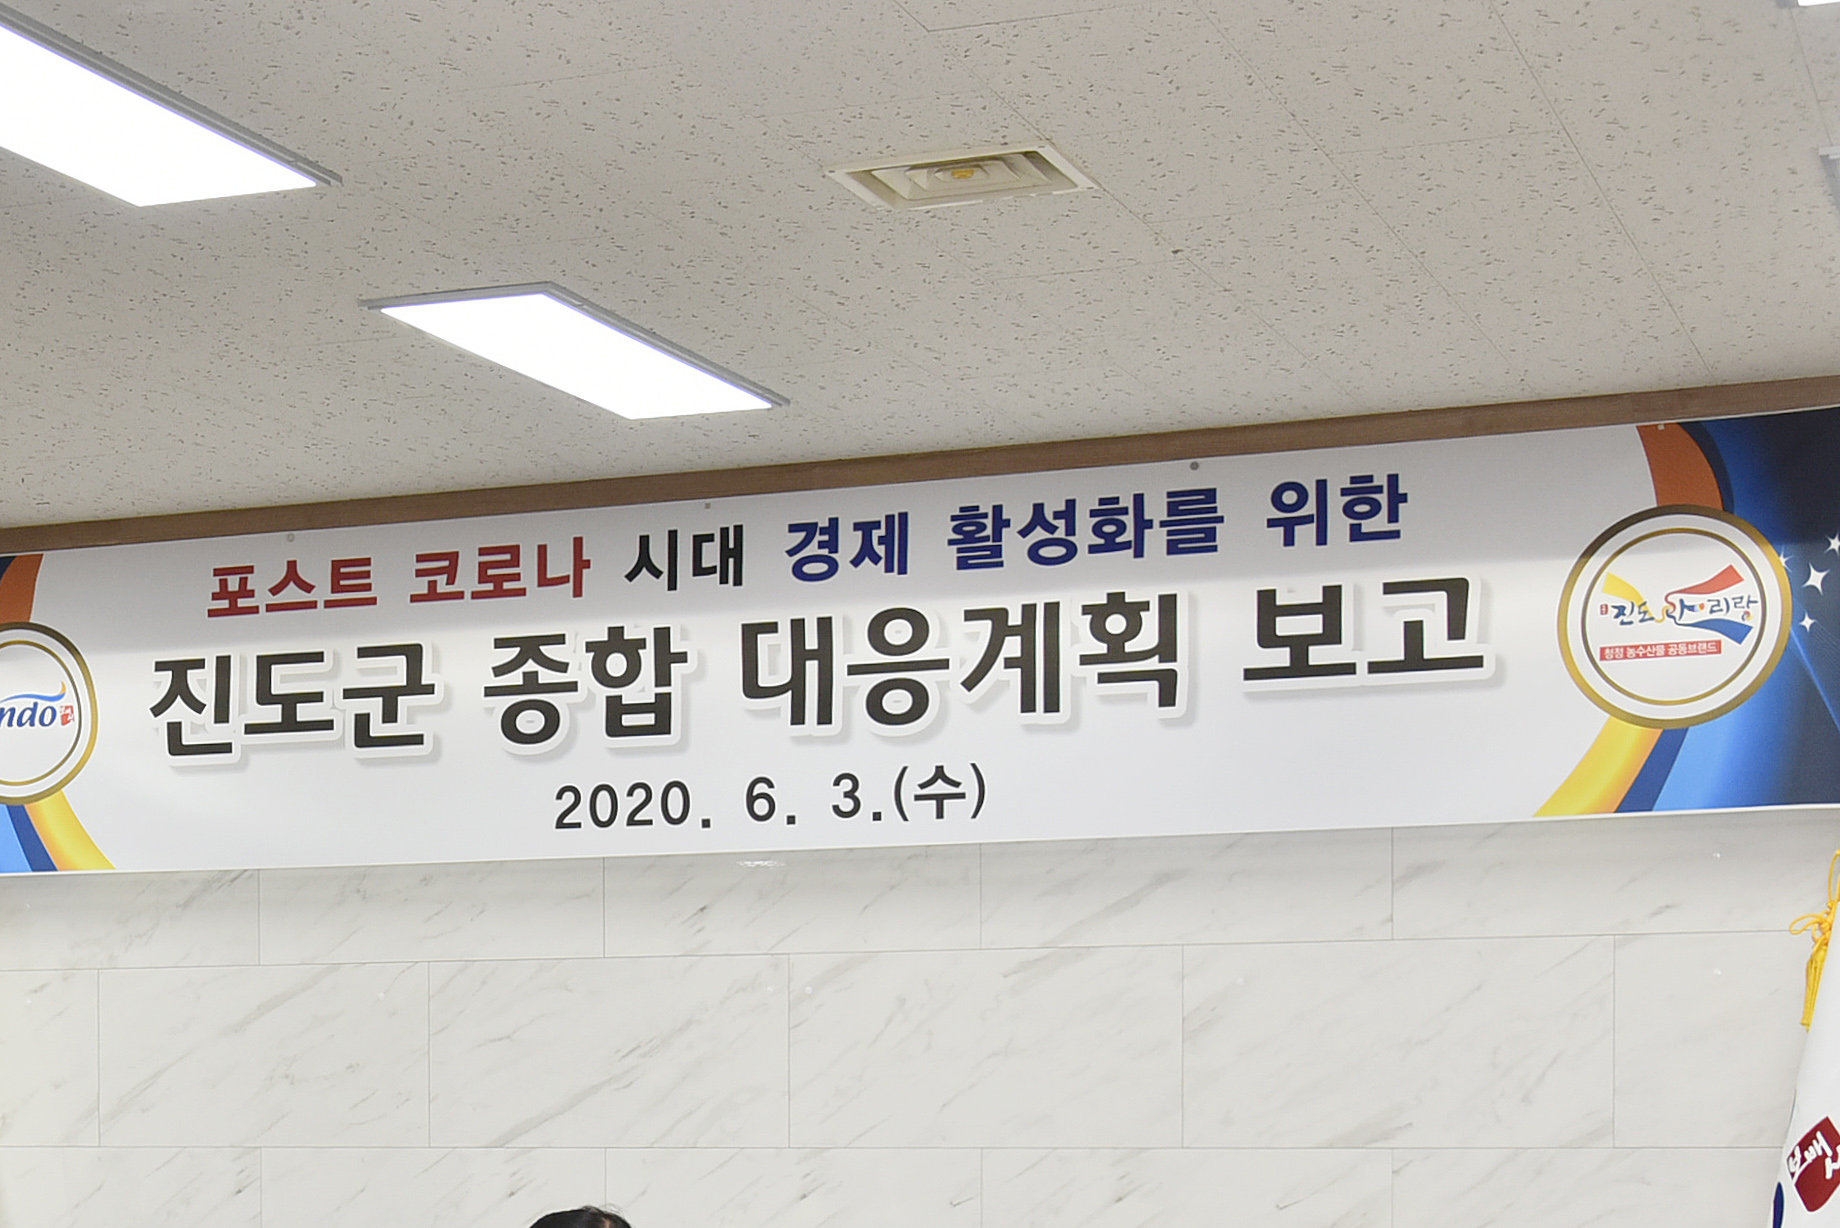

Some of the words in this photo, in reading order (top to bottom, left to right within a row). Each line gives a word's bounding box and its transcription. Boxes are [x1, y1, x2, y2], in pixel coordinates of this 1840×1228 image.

[208, 557, 377, 617] 포스트
[410, 536, 590, 603] 코로나
[625, 524, 743, 591] 시대
[785, 512, 908, 582] 경제
[948, 488, 1224, 570] 활성화를
[1267, 474, 1408, 547] 위한
[150, 644, 434, 756] 진도군
[485, 626, 687, 744] 종합
[742, 592, 1177, 725] 대응계획
[1244, 578, 1483, 680] 보고
[1604, 646, 1624, 660] 청정
[1626, 644, 1666, 659] 농수산물
[1667, 641, 1719, 656] 공동브랜드
[556, 781, 710, 829] 2020.
[747, 777, 795, 824] 6.
